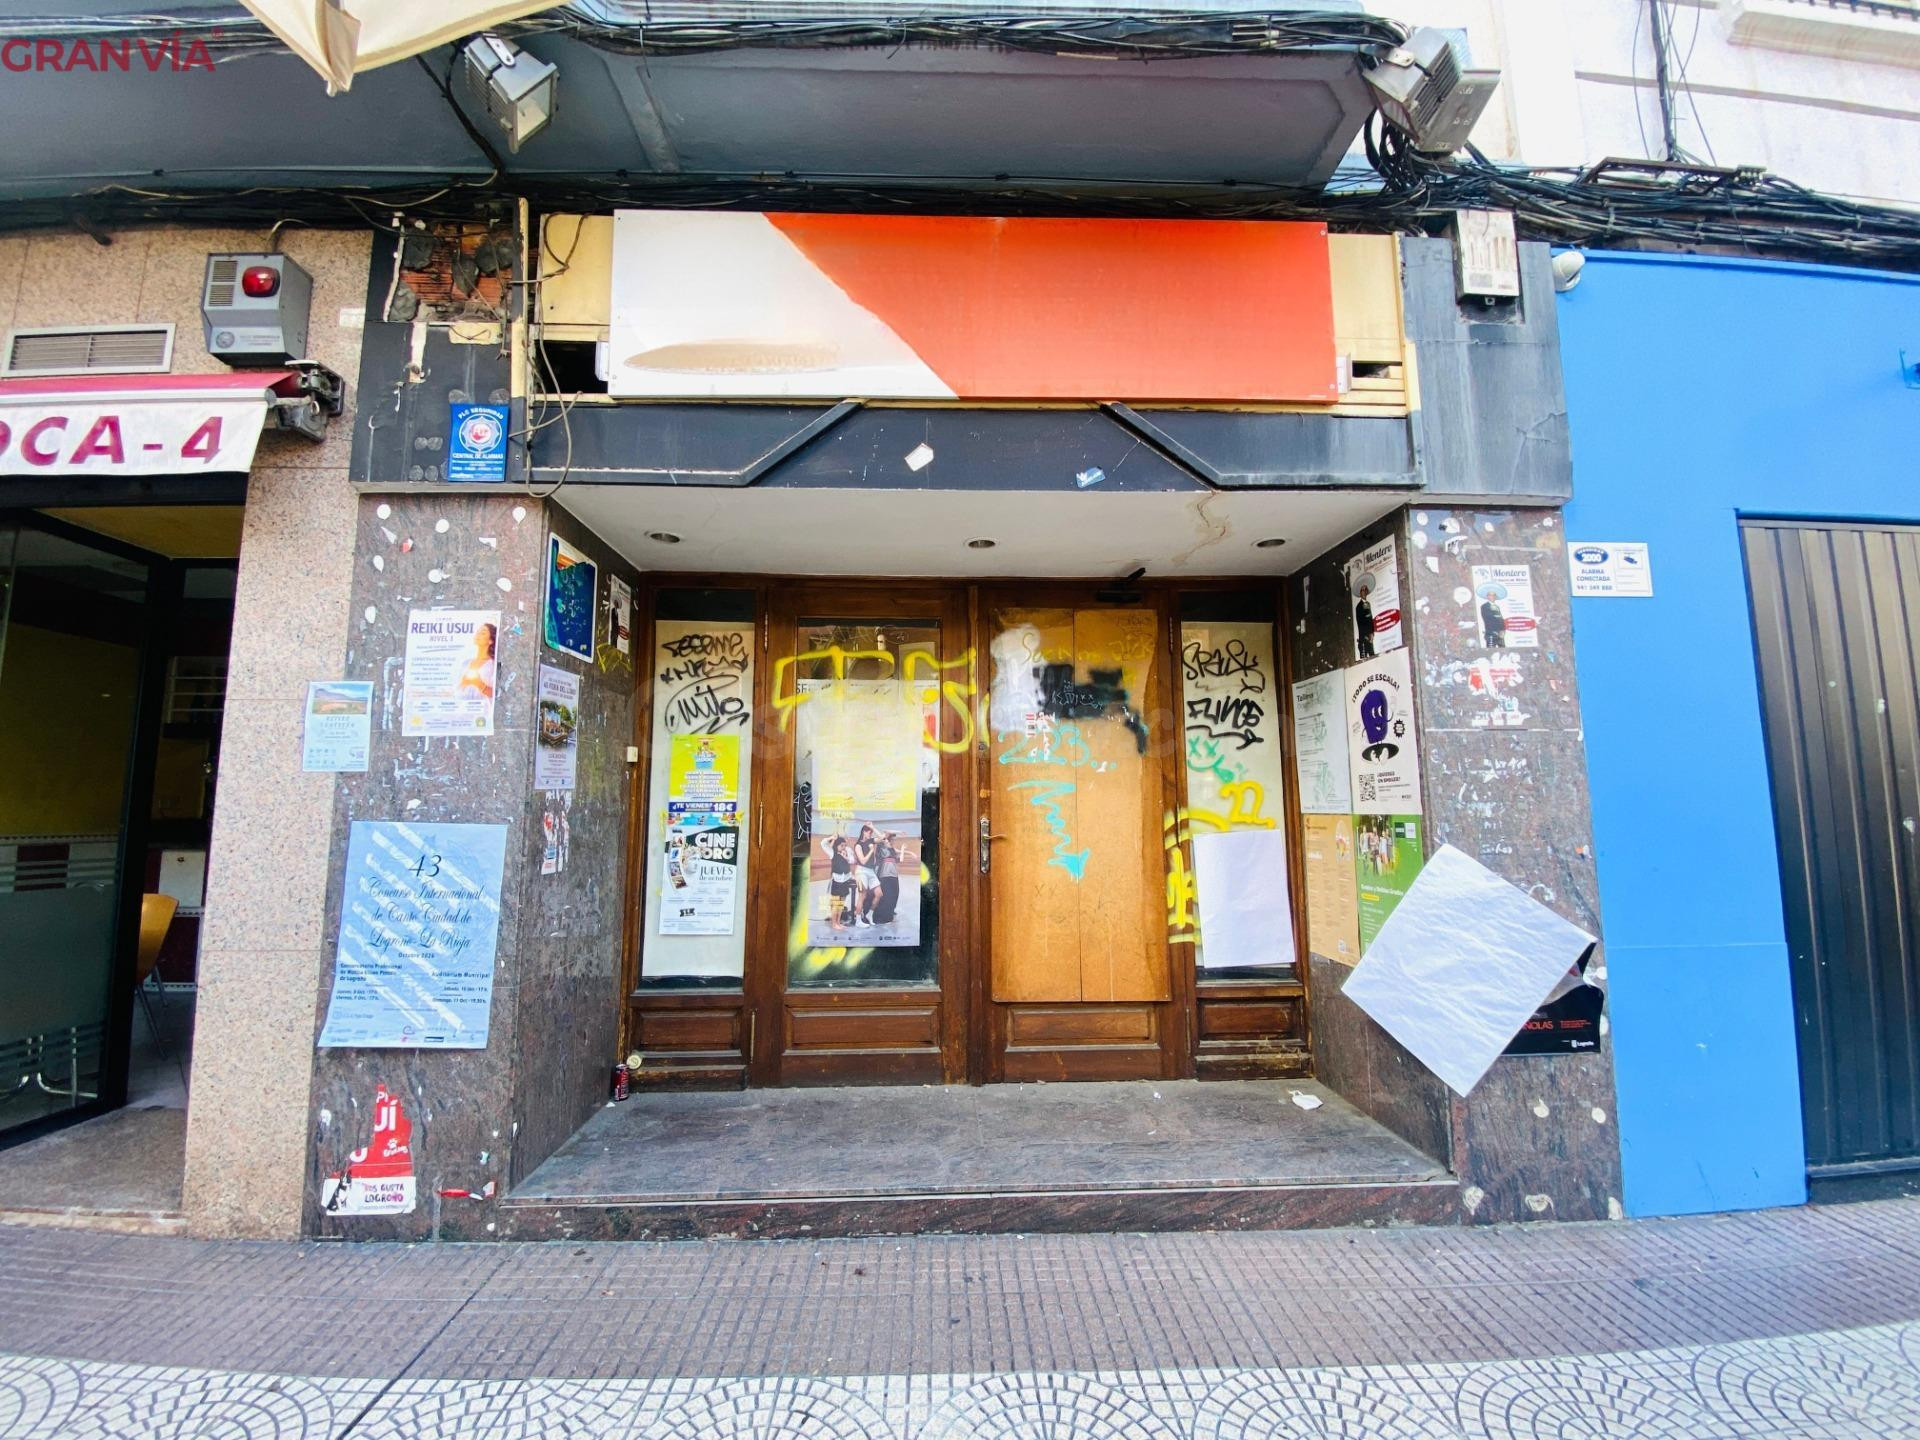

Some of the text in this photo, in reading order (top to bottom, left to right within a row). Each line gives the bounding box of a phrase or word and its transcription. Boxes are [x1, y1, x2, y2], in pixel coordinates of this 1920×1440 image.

[0, 415, 125, 467] CA
[1493, 568, 1527, 577] Montero
[411, 622, 474, 634] REIKI USUI
[695, 832, 736, 848] CINE
[408, 854, 442, 877] 43
[700, 865, 734, 876] JUEVES
[417, 880, 486, 900] Internacional
[1524, 1021, 1553, 1030] NOLAS
